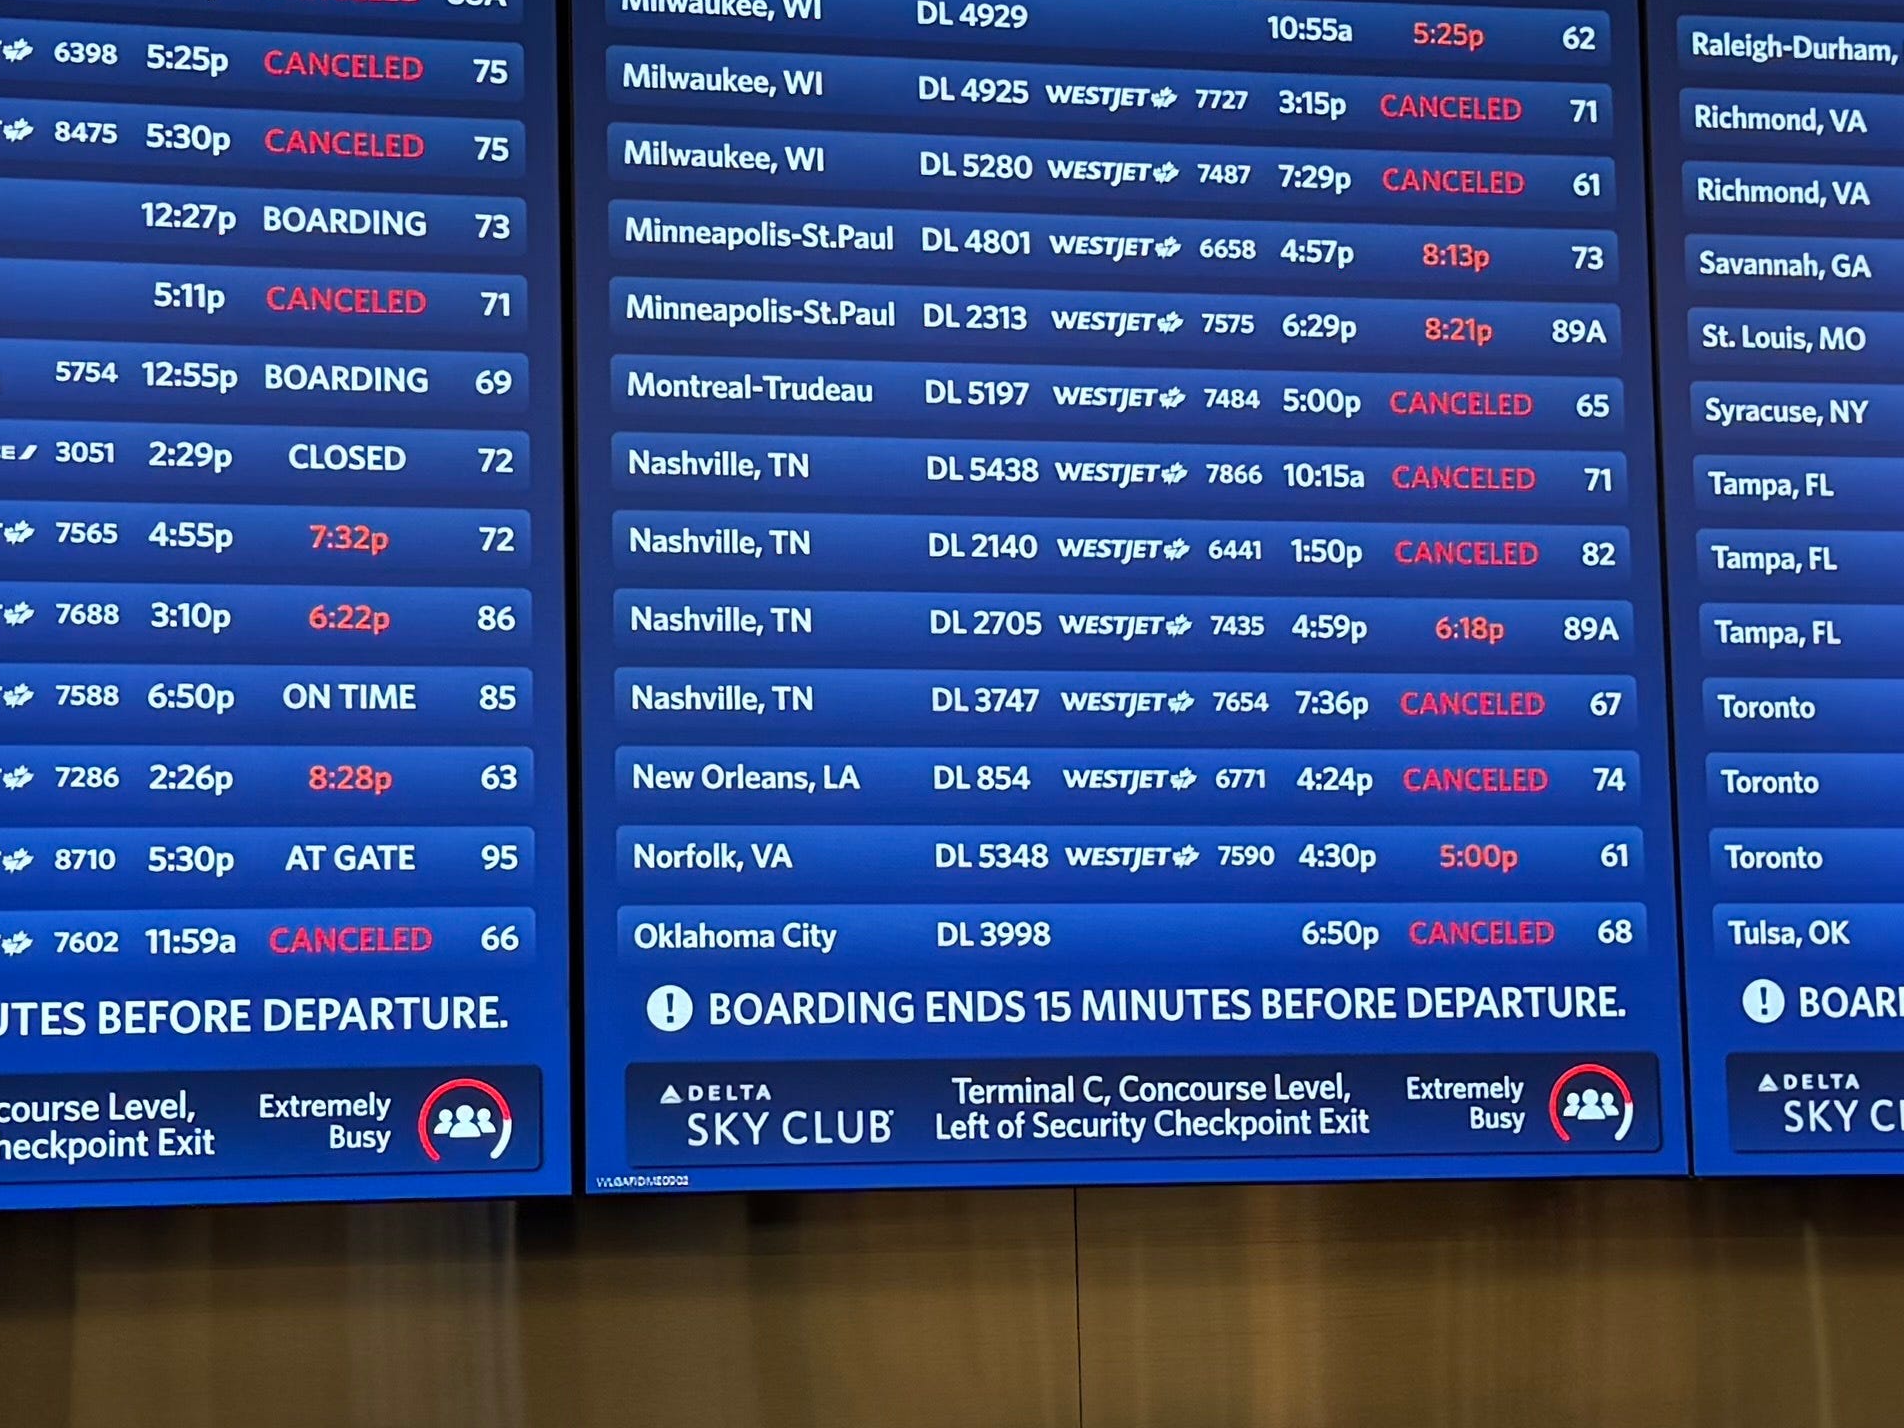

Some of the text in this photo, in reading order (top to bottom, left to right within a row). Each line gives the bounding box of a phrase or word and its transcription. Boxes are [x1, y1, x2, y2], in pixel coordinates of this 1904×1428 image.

[1717, 694, 1815, 718] Toronto
[99, 999, 251, 1034] BEFORE
[264, 996, 508, 1031] DEPARTURE.
[110, 1090, 195, 1123] Level,
[260, 1092, 391, 1121] Extremely
[159, 1128, 215, 1156] Exit
[330, 1124, 391, 1153] Busy
